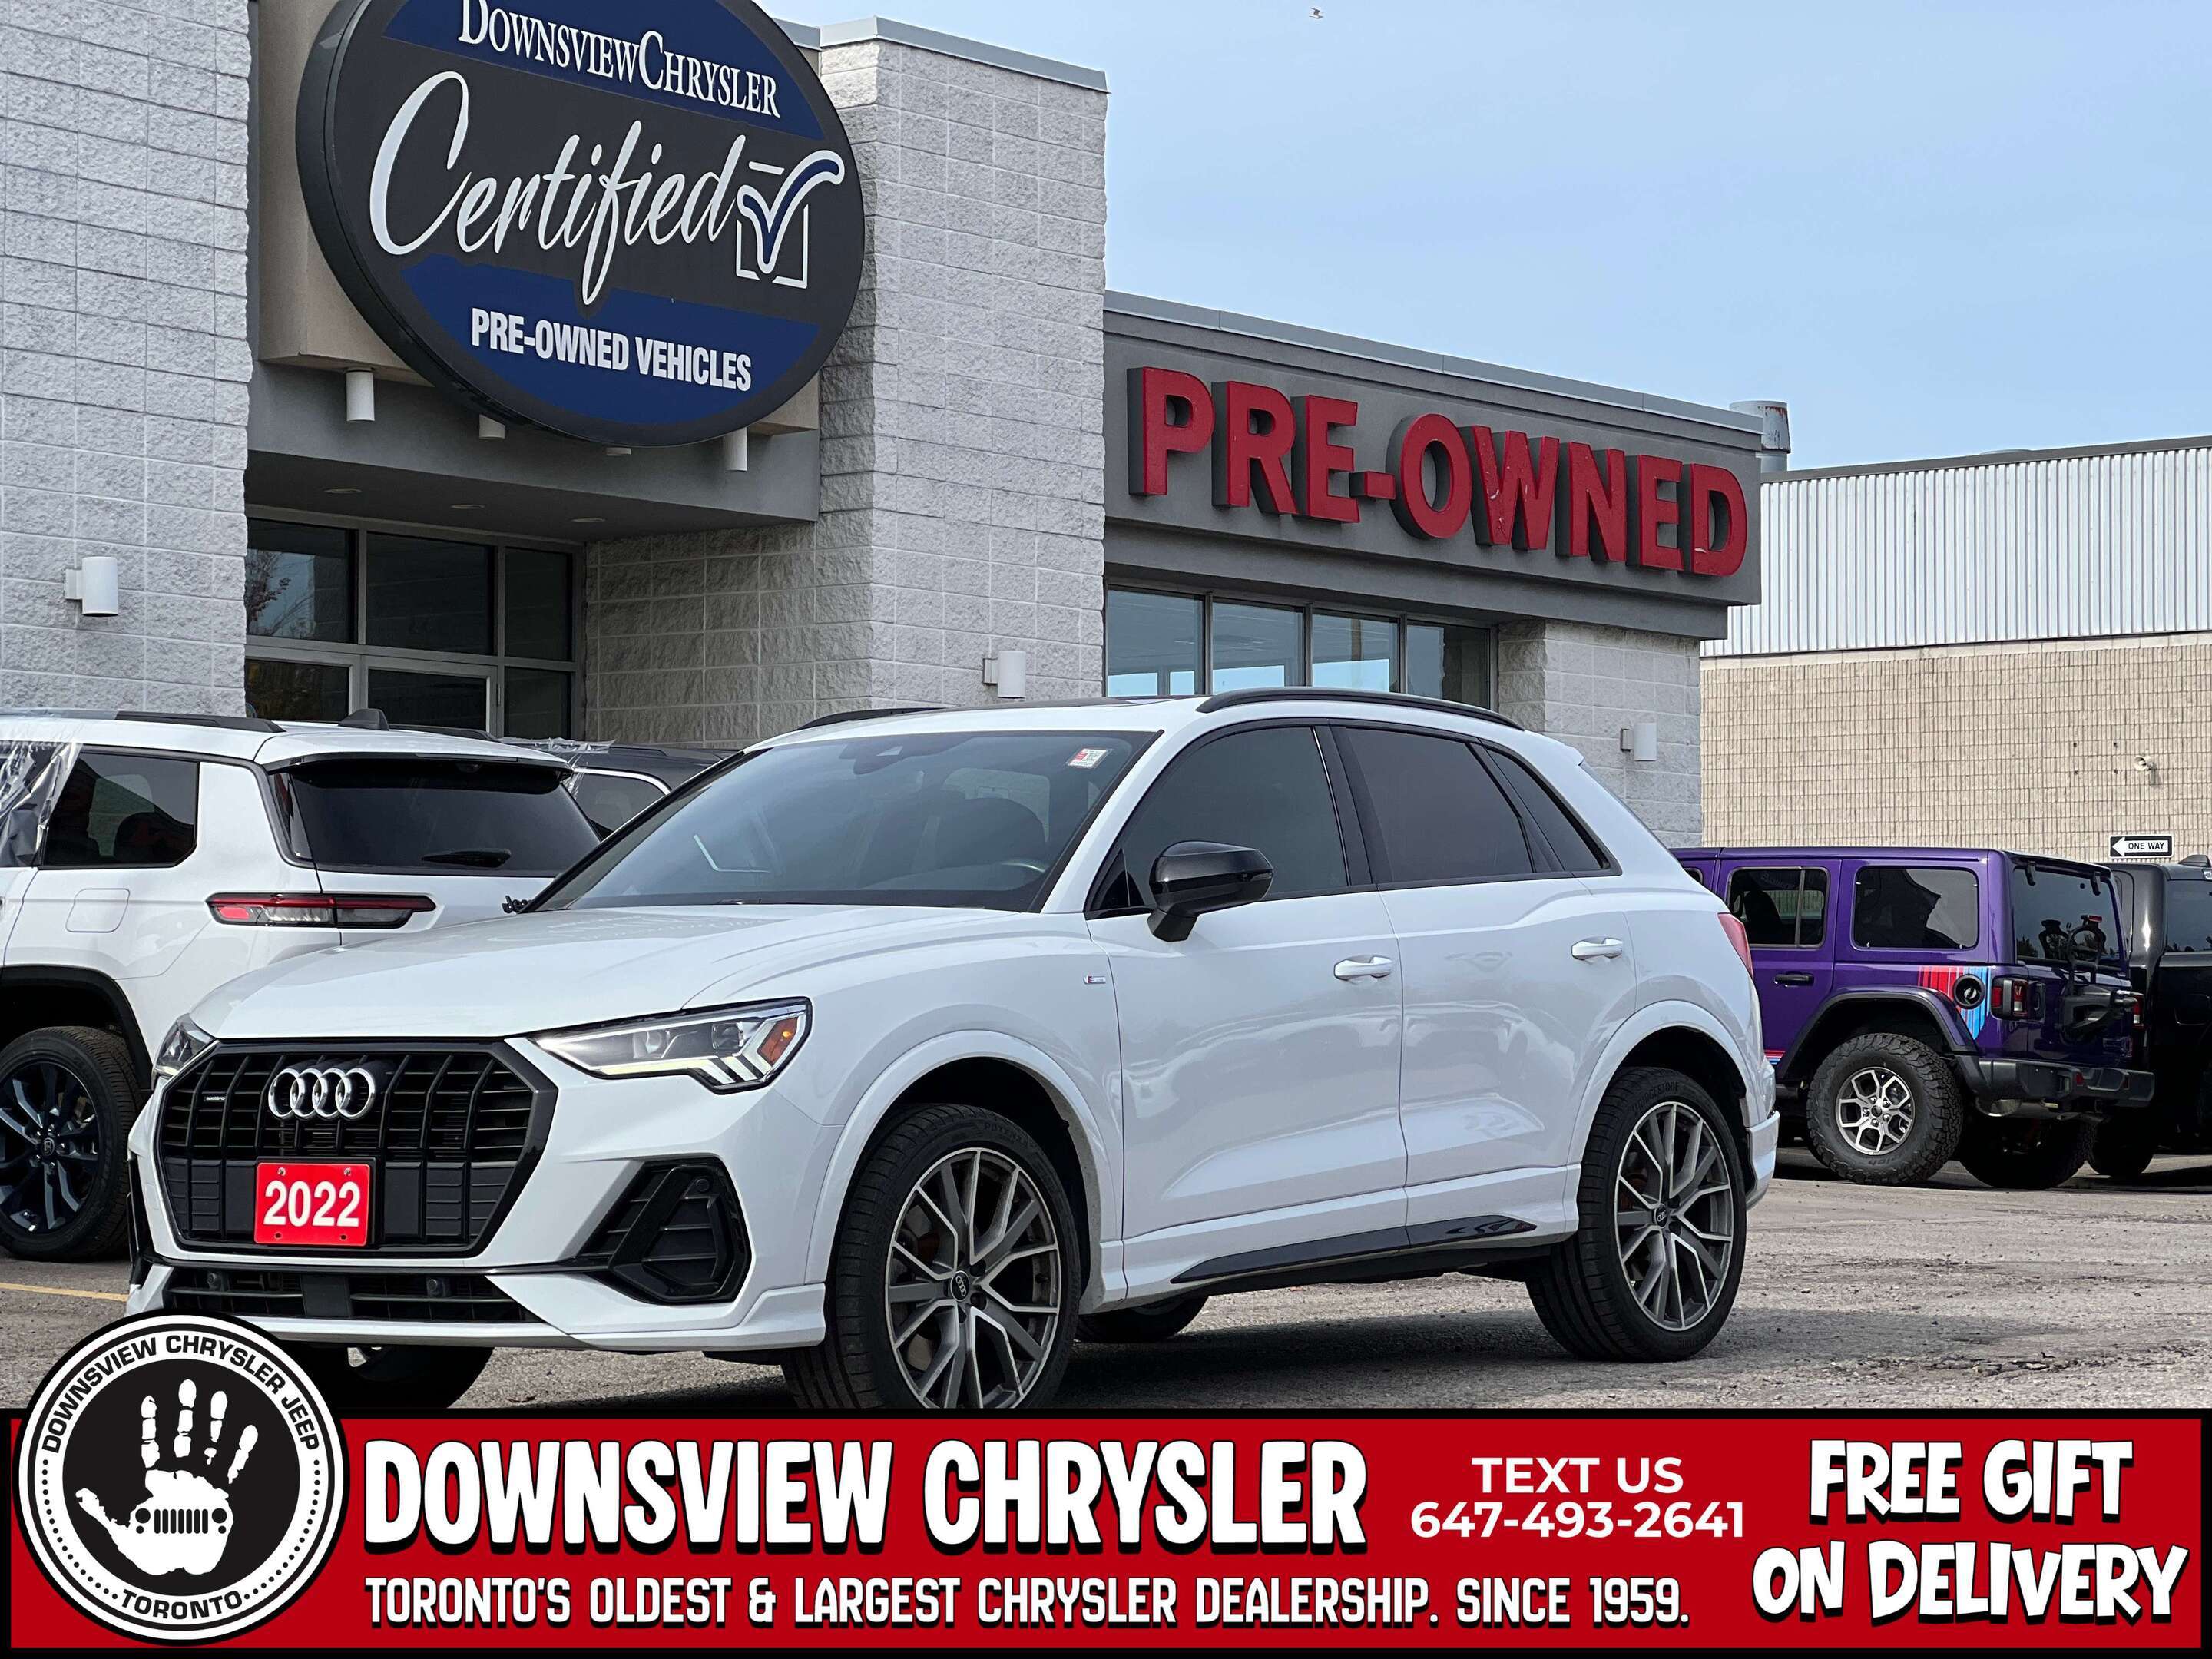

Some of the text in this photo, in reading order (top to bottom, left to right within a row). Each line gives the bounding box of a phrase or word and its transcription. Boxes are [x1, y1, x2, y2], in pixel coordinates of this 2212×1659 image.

[369, 71, 747, 306] Certified
[471, 307, 752, 392] PRE-OWNED VEHICLES
[1141, 367, 1747, 576] PRE-OWNED
[2128, 842, 2145, 850] ONE
[502, 895, 534, 914] Jee
[263, 1180, 361, 1227] 2022
